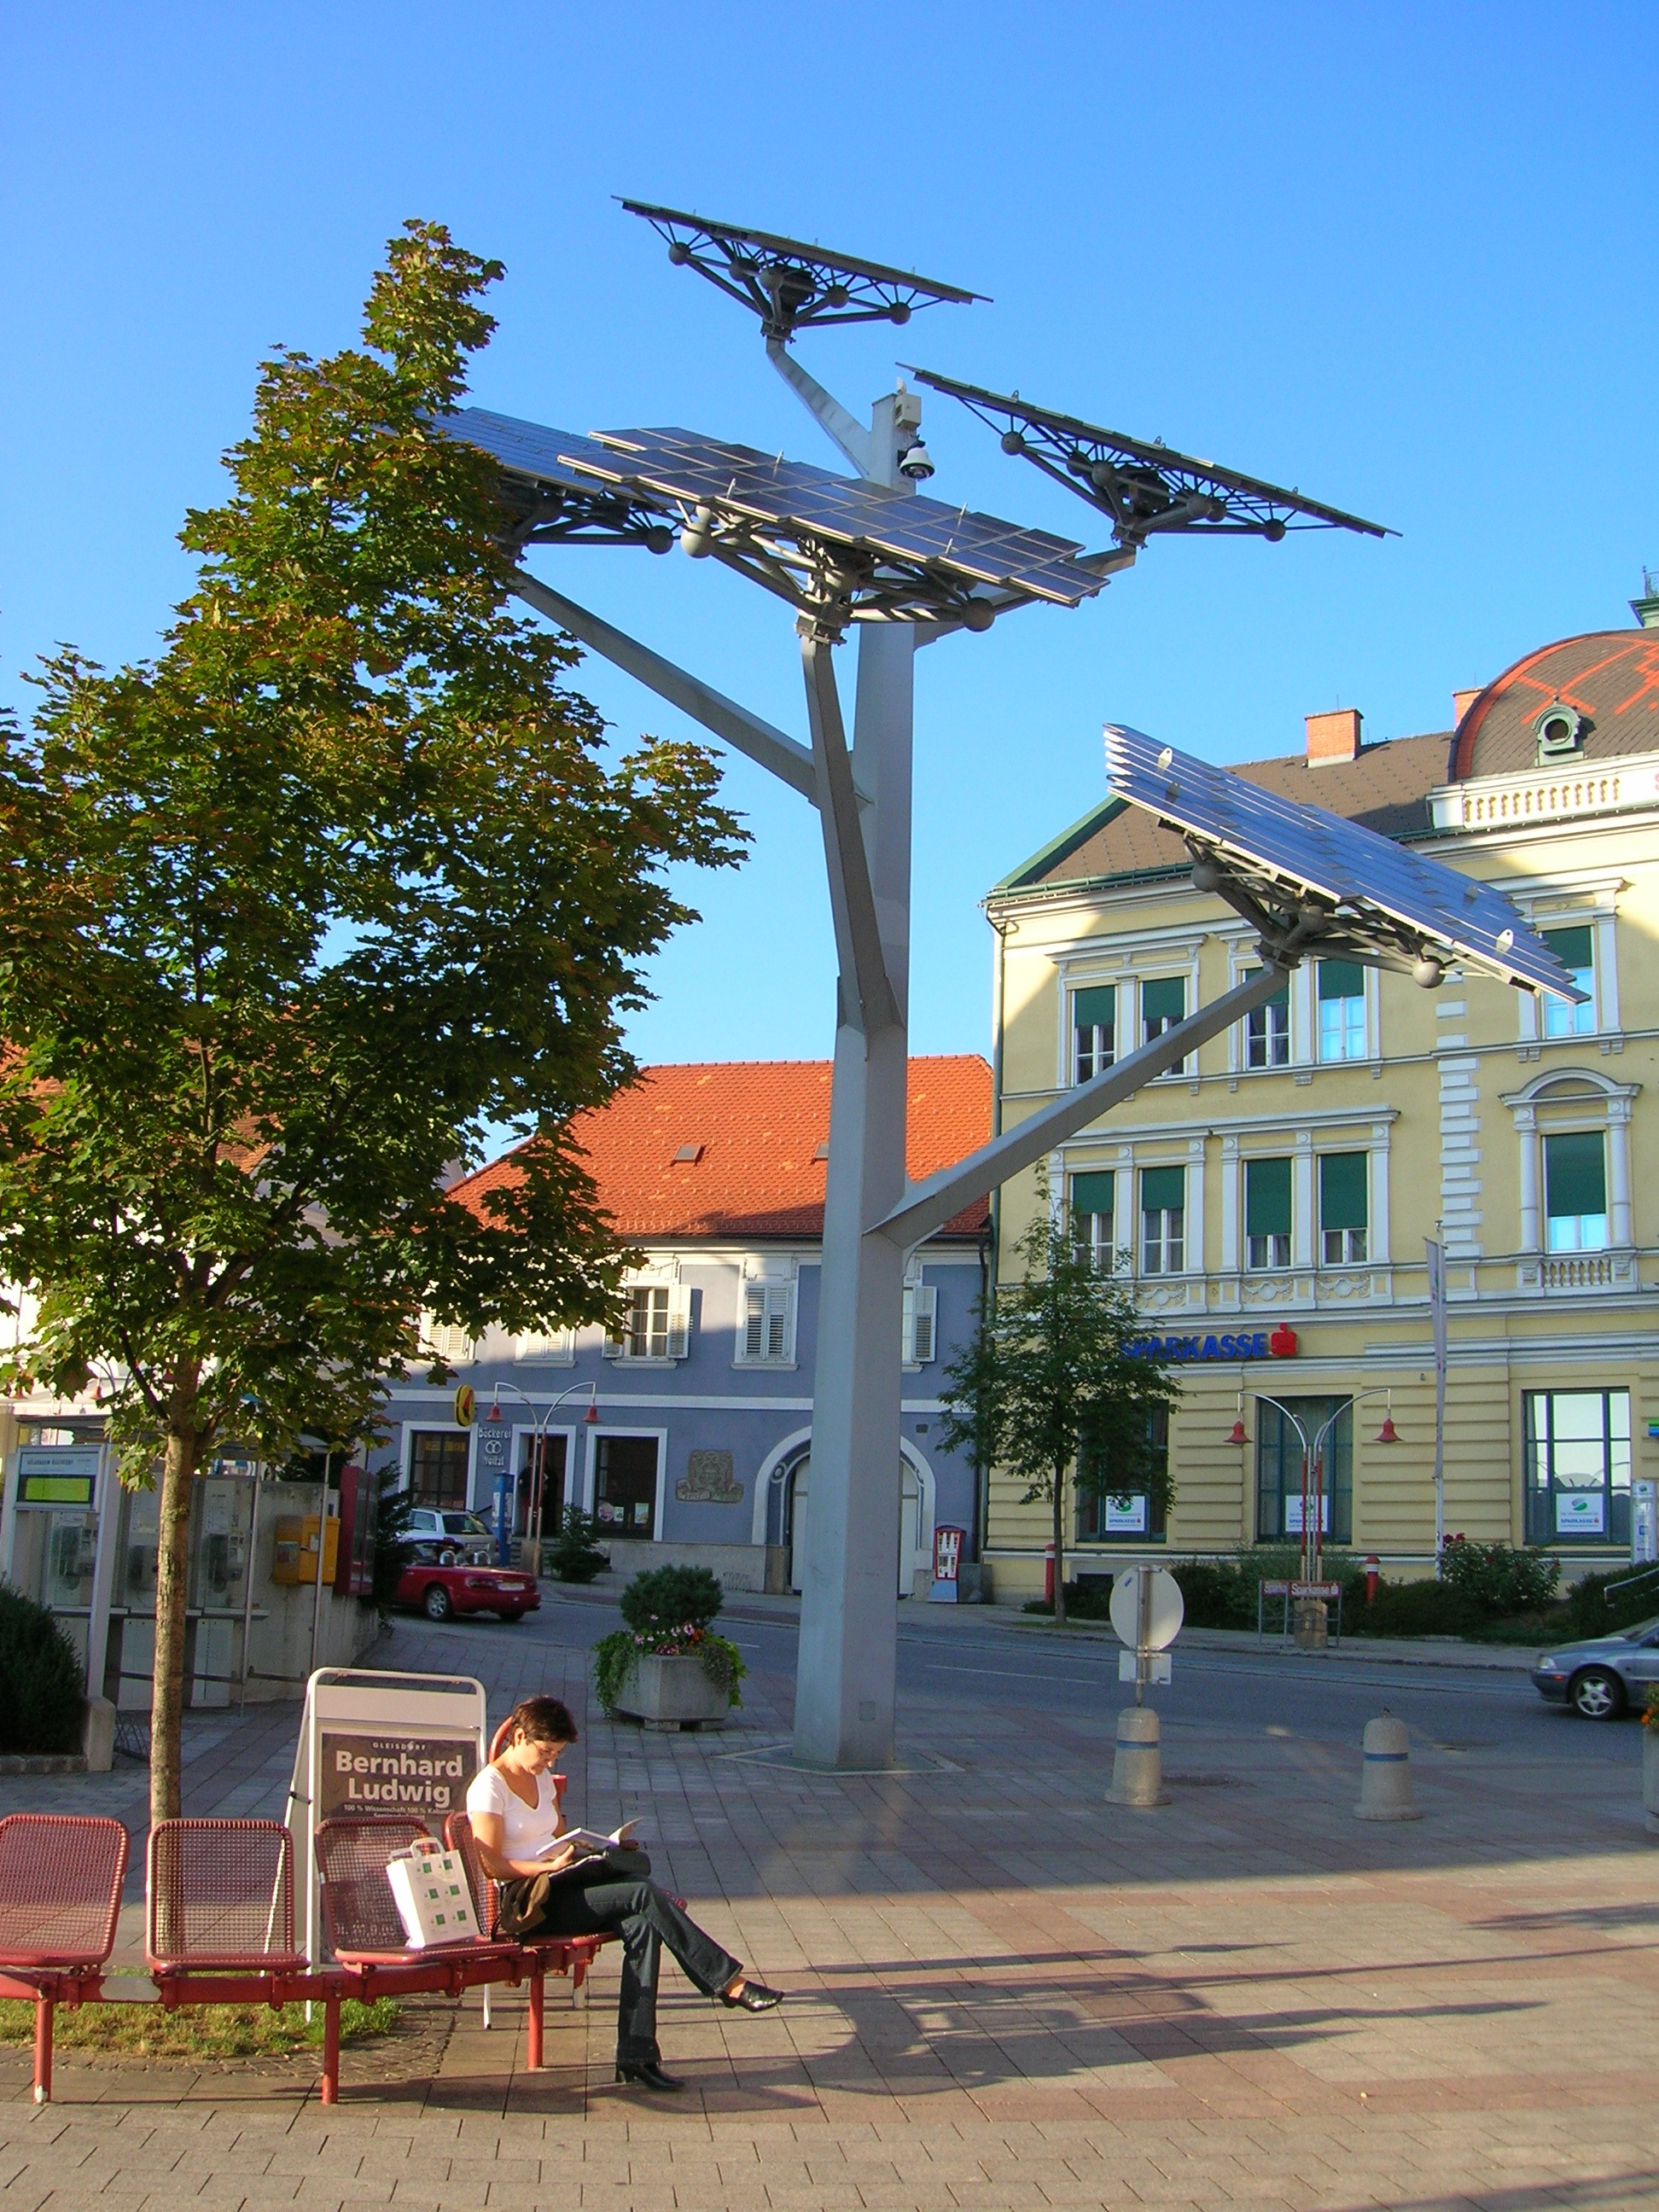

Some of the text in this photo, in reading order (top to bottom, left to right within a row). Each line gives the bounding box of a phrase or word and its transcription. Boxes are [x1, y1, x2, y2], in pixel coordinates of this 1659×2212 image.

[1291, 1583, 1330, 1596] Sparkasse
[335, 1749, 463, 1778] Bernhard
[348, 1777, 451, 1808] Ludwig
[364, 1804, 406, 1813] Wissenschaft
